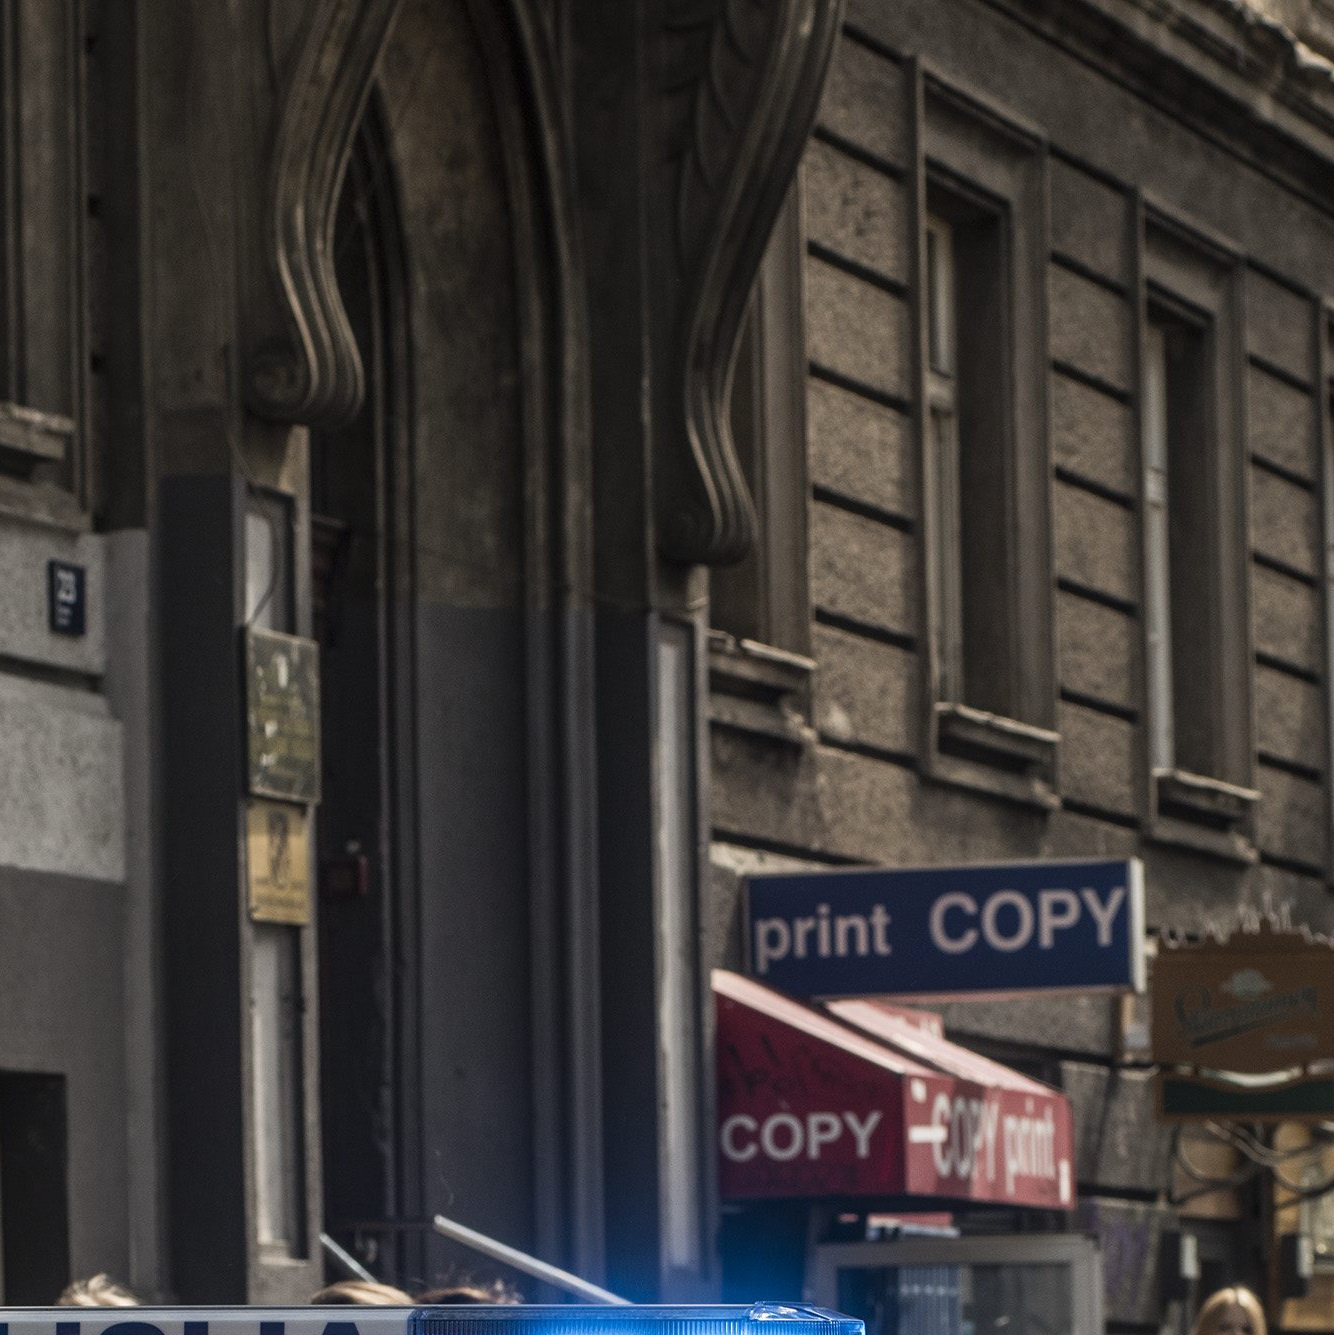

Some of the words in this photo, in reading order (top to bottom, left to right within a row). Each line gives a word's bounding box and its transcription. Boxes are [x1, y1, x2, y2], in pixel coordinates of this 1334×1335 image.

[753, 903, 893, 974] print
[927, 885, 1127, 955] COPY
[720, 1110, 883, 1162] COPY
[930, 1092, 1000, 1184] COPY
[1004, 1098, 1057, 1197] print
